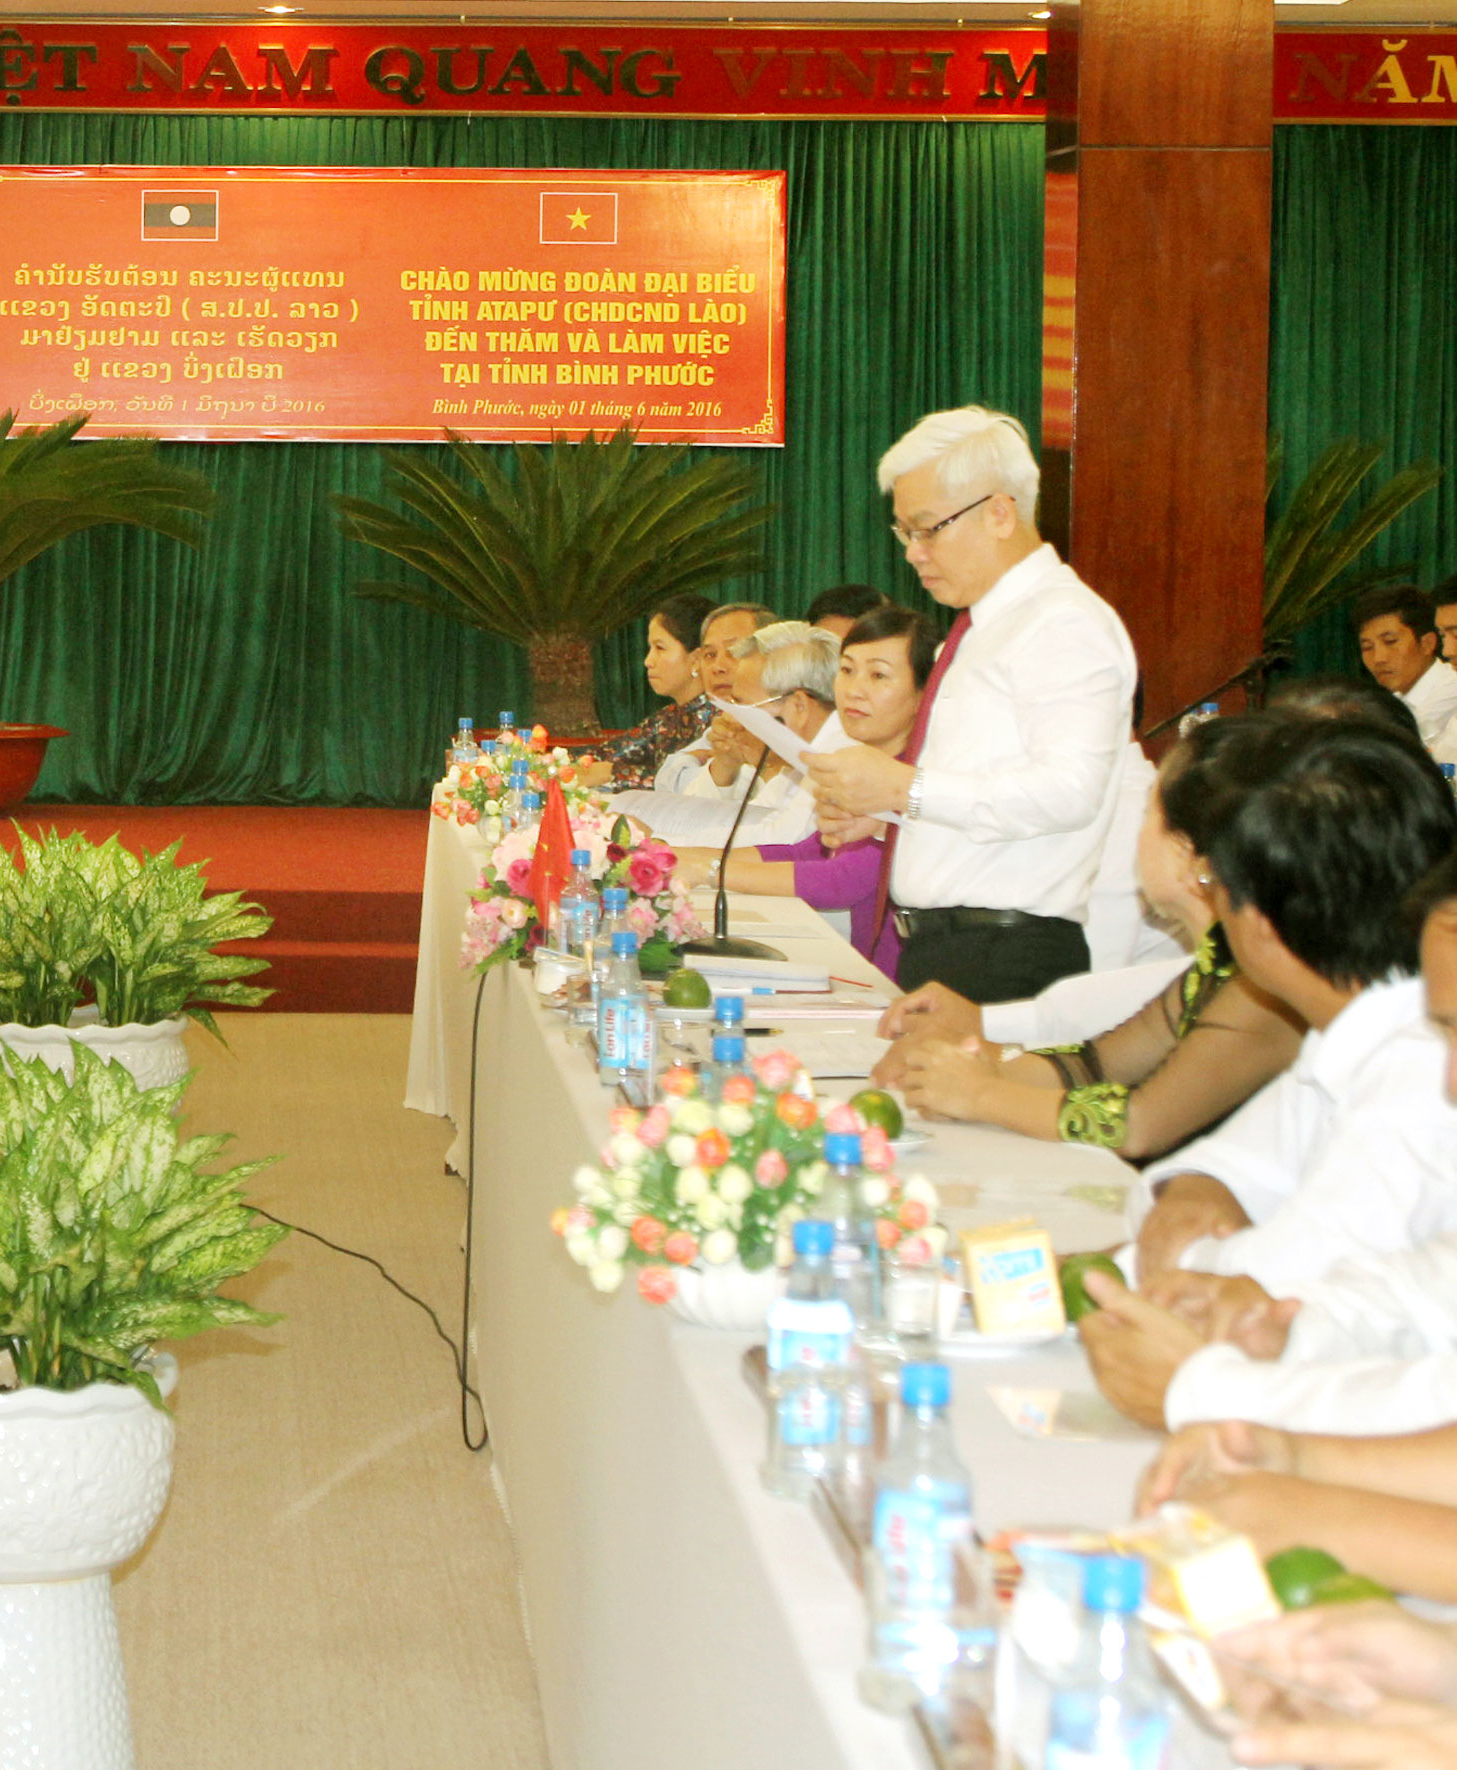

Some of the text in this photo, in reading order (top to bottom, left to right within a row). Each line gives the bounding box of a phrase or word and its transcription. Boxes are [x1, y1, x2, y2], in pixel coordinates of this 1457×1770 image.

[127, 43, 340, 97] NAM
[364, 45, 682, 104] QUANG
[713, 47, 954, 100] VINH
[400, 265, 756, 298] CHÀO MỪNG ĐOÀN ĐẠI BIỂU
[409, 294, 747, 325] TỈNH ATAPƯ (CHDCND LÀO)
[425, 325, 730, 359] ĐẾN THĂM VÀ LÀM VIỆC
[440, 358, 714, 388] TẠI TỈNH BÌNH PHƯỚC
[282, 399, 326, 414] 2016
[432, 399, 722, 421] Bình Phước, ngày 01 tháng 6 năm 2016
